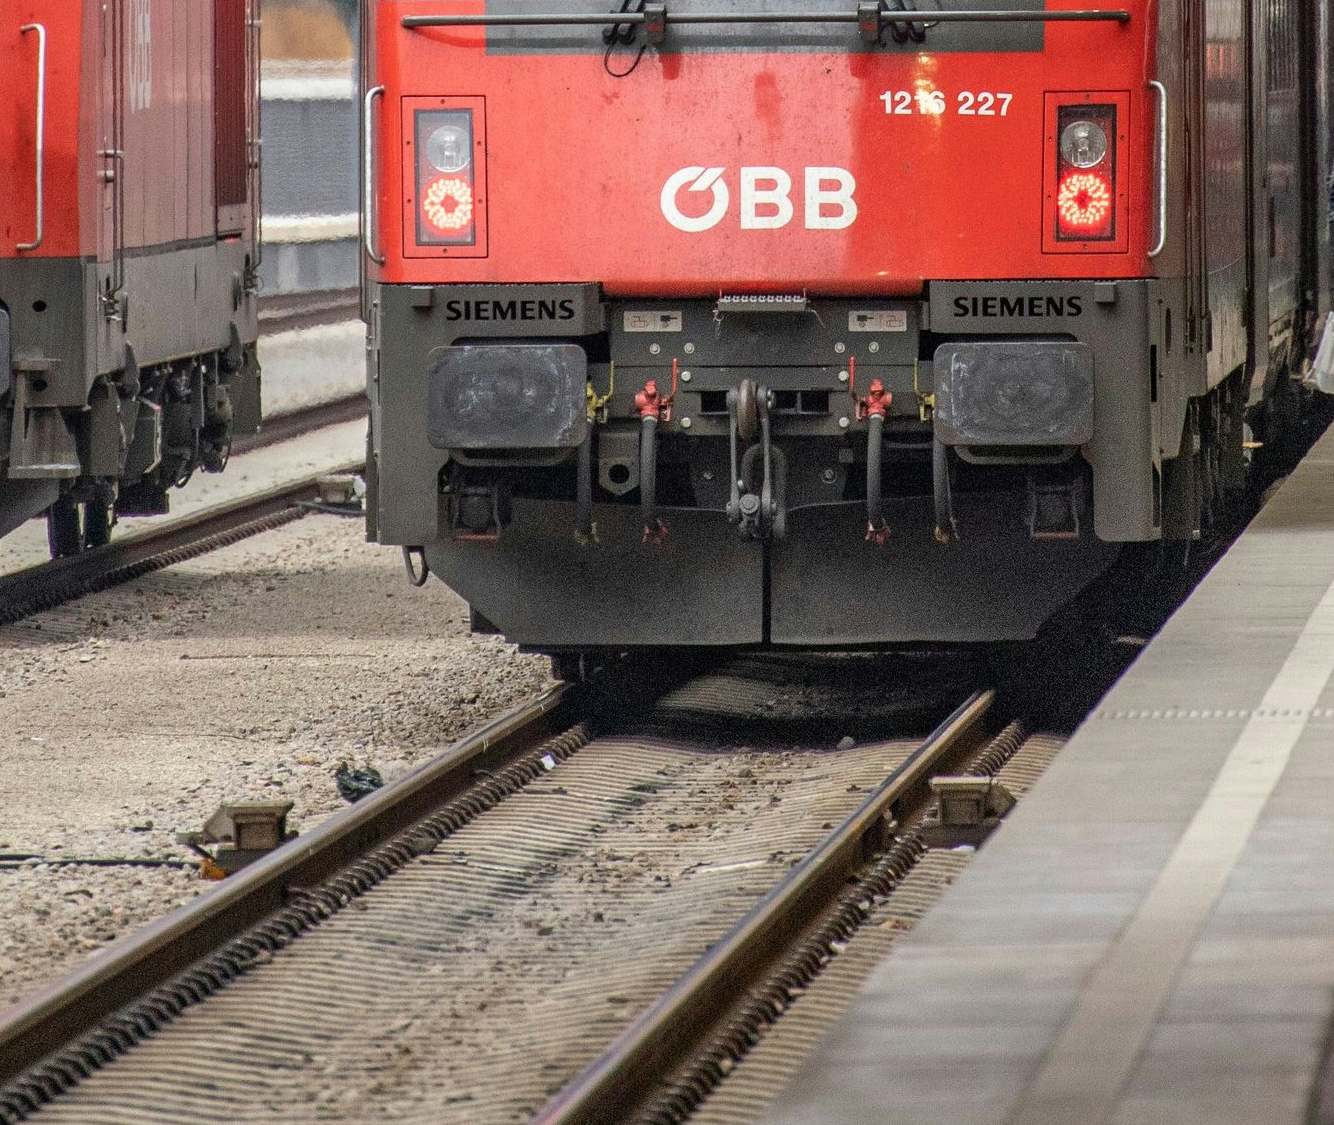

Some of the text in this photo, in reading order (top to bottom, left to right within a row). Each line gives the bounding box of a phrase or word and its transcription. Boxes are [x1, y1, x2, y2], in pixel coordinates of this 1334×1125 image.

[880, 90, 1012, 115] 1216 227
[660, 166, 857, 232] ÖBB
[446, 299, 575, 321] SIEMENS
[953, 296, 1082, 317] SIEMENS
